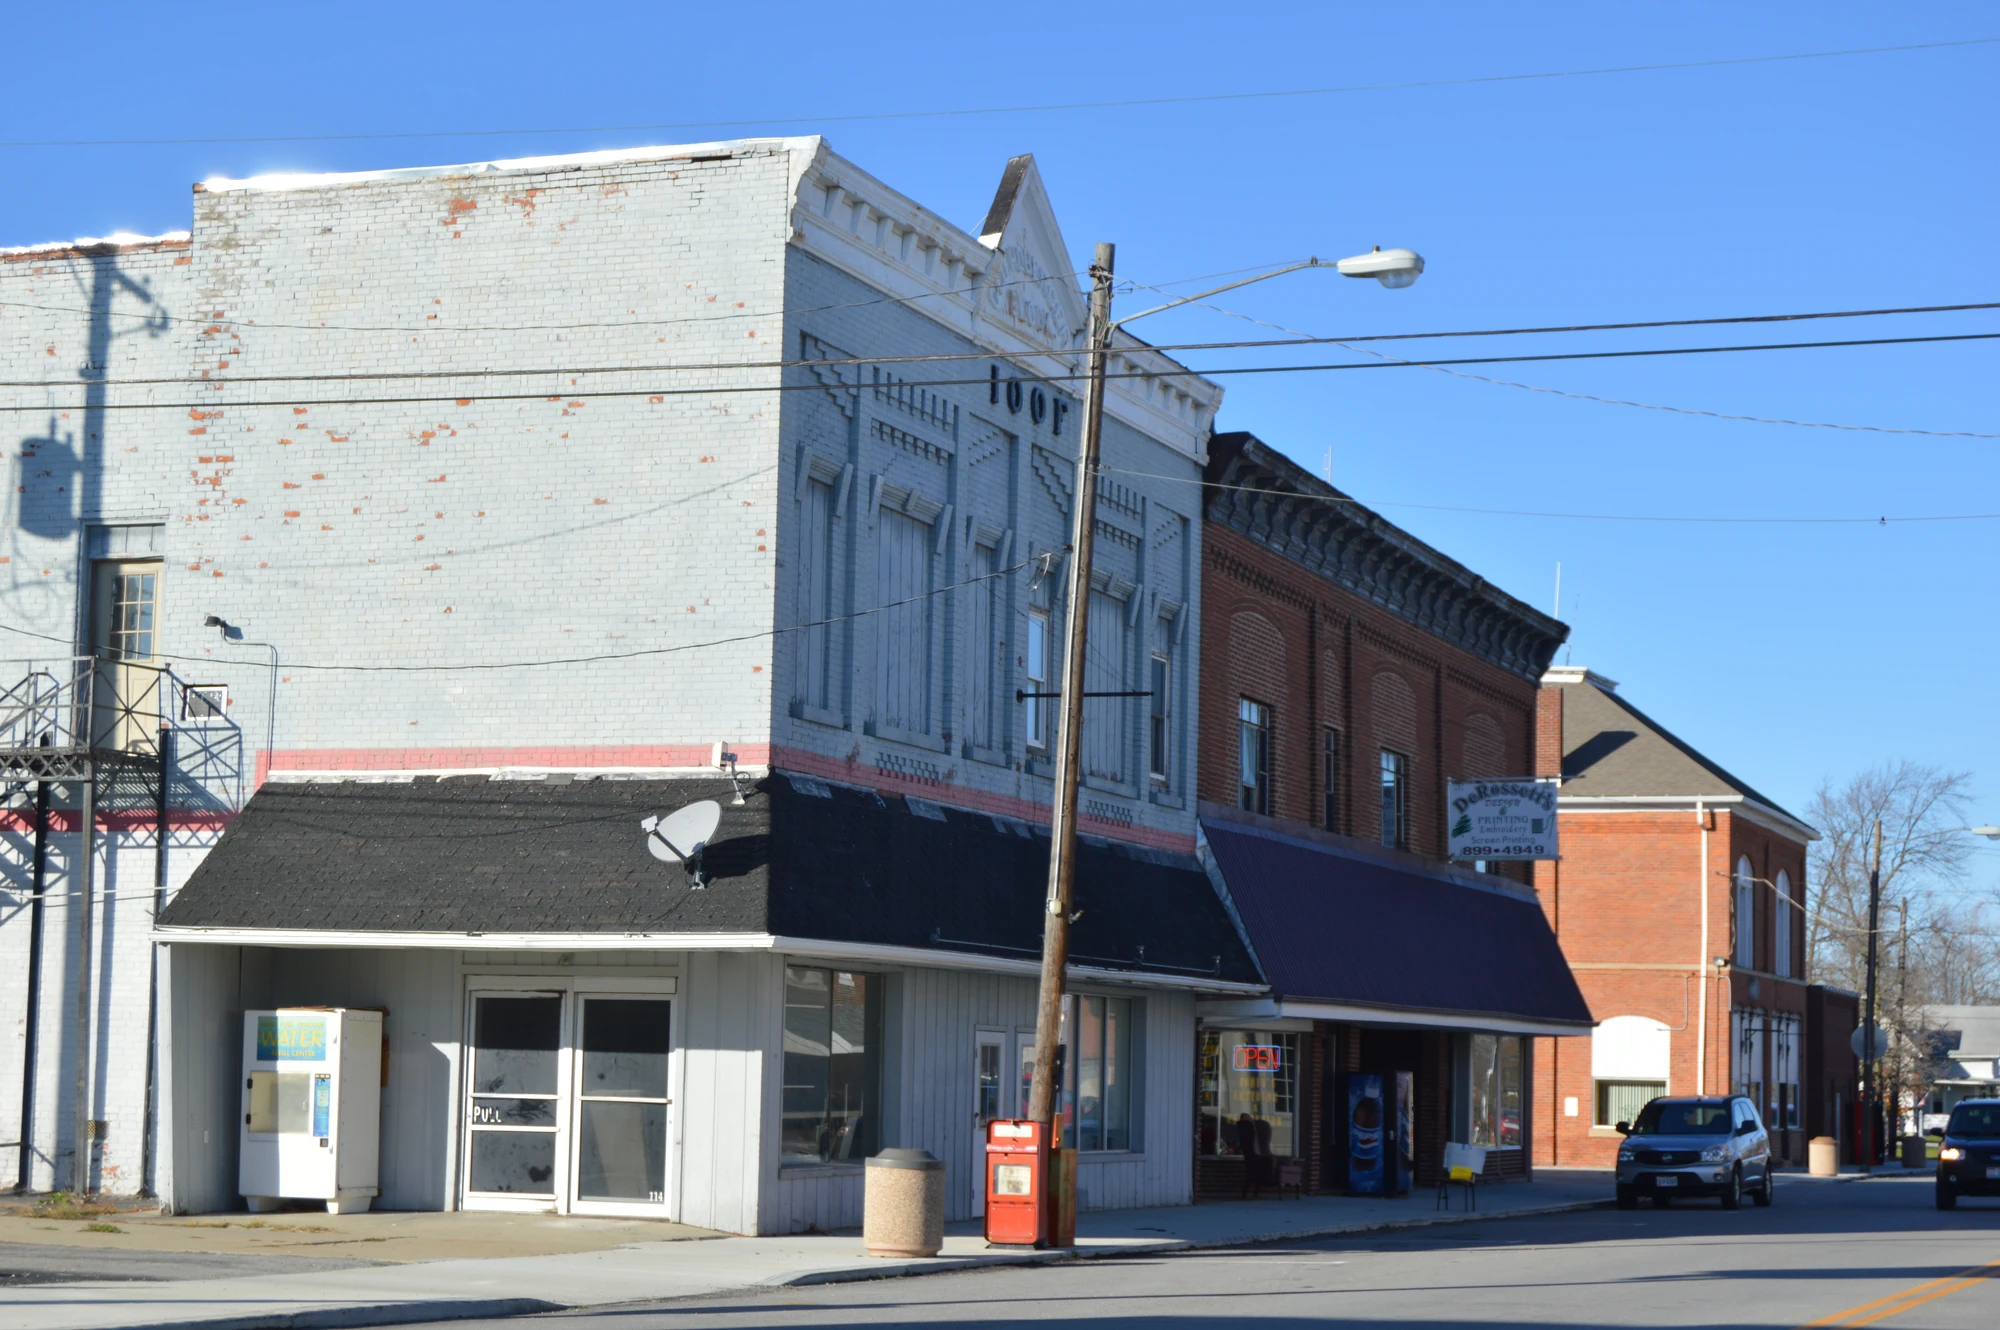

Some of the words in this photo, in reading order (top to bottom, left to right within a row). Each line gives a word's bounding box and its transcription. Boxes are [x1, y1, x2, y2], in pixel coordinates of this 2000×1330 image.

[990, 364, 1068, 436] IOOF
[1452, 783, 1554, 813] DeRossett's
[1477, 816, 1528, 824] PRINTING
[1480, 825, 1527, 836] Embroidery
[1471, 836, 1500, 844] Screen
[1502, 835, 1536, 844] Printing
[261, 1029, 323, 1048] WATER
[1235, 1046, 1278, 1069] OPEN
[649, 1191, 663, 1202] 114
